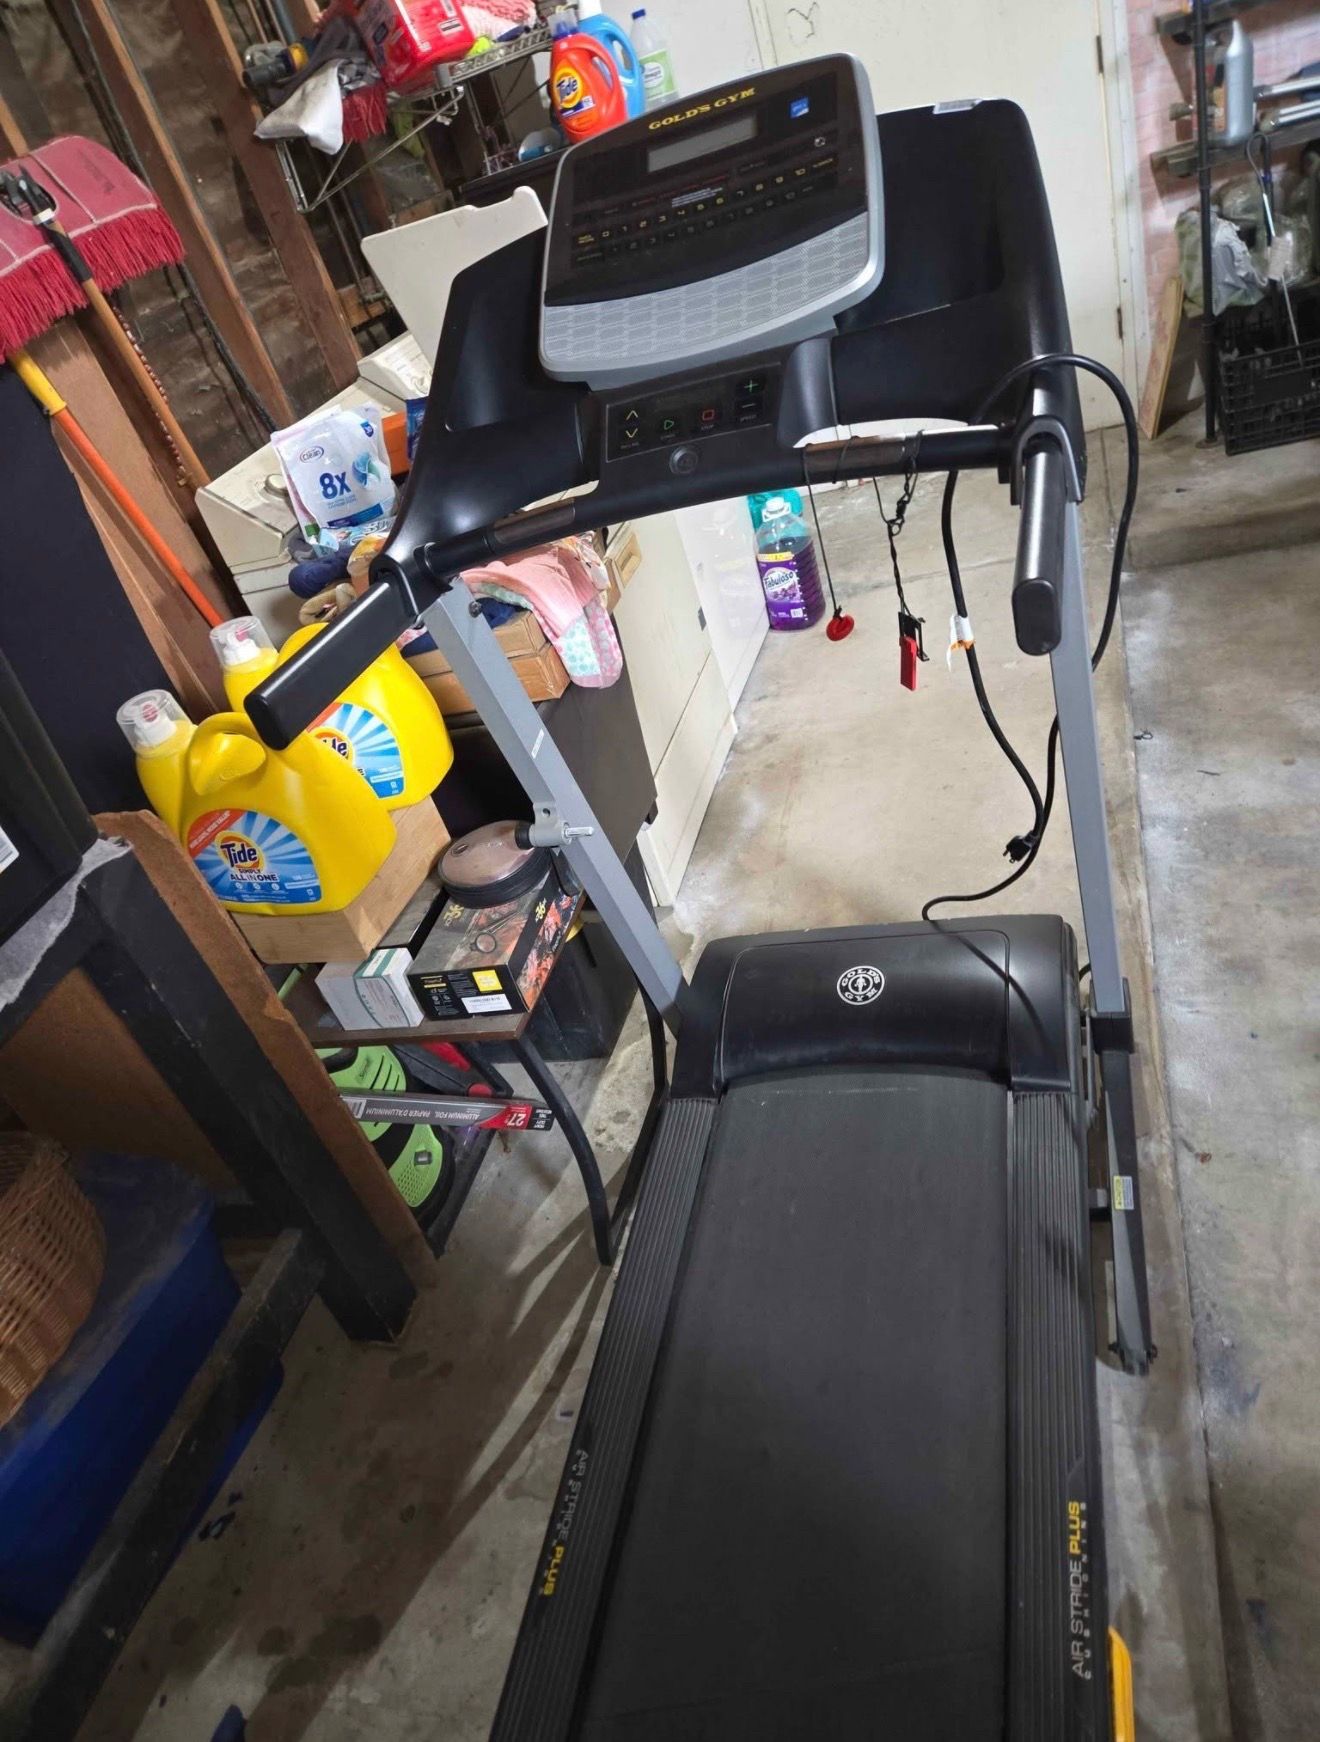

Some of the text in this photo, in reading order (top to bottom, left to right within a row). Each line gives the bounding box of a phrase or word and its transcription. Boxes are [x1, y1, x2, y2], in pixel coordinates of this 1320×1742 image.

[649, 88, 756, 130] GOLD'S GYM
[763, 571, 794, 588] Fabuloso
[220, 841, 258, 868] Tide
[844, 987, 878, 1002] GYM
[408, 1109, 431, 1118] PAPIER
[434, 1110, 449, 1119] FOIL
[448, 1111, 481, 1120] ALUMINUM
[509, 1112, 526, 1127] 27
[543, 1546, 565, 1596] PLUS
[1068, 1501, 1084, 1678] AIR STRIDE PLUS
